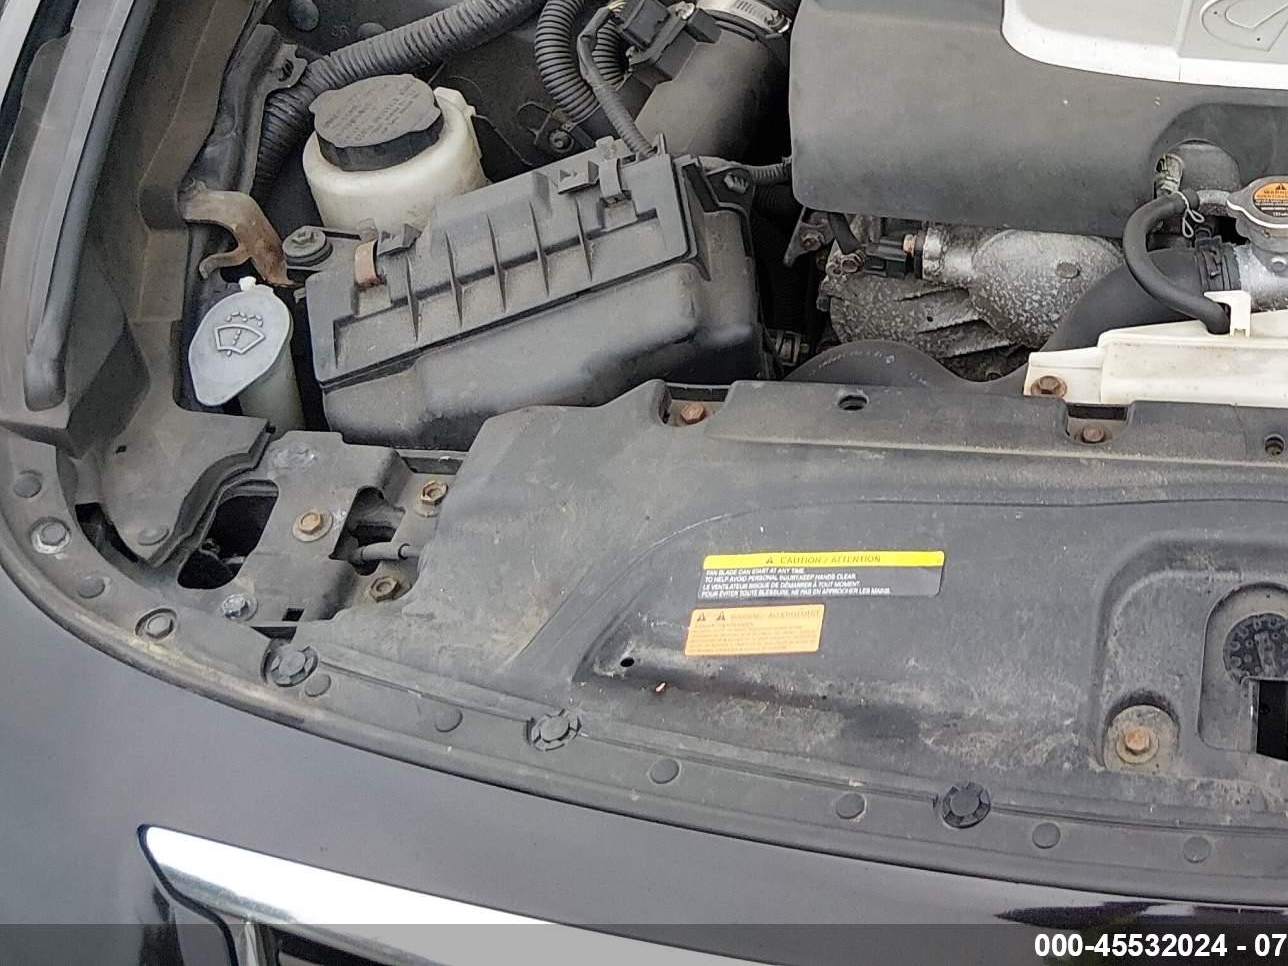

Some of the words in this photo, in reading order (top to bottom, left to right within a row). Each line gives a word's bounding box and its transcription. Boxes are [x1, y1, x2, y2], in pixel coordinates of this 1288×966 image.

[780, 556, 822, 565] CAUTION
[831, 554, 881, 564] ATTENTION
[704, 576, 714, 584] TO
[702, 583, 711, 591] LE
